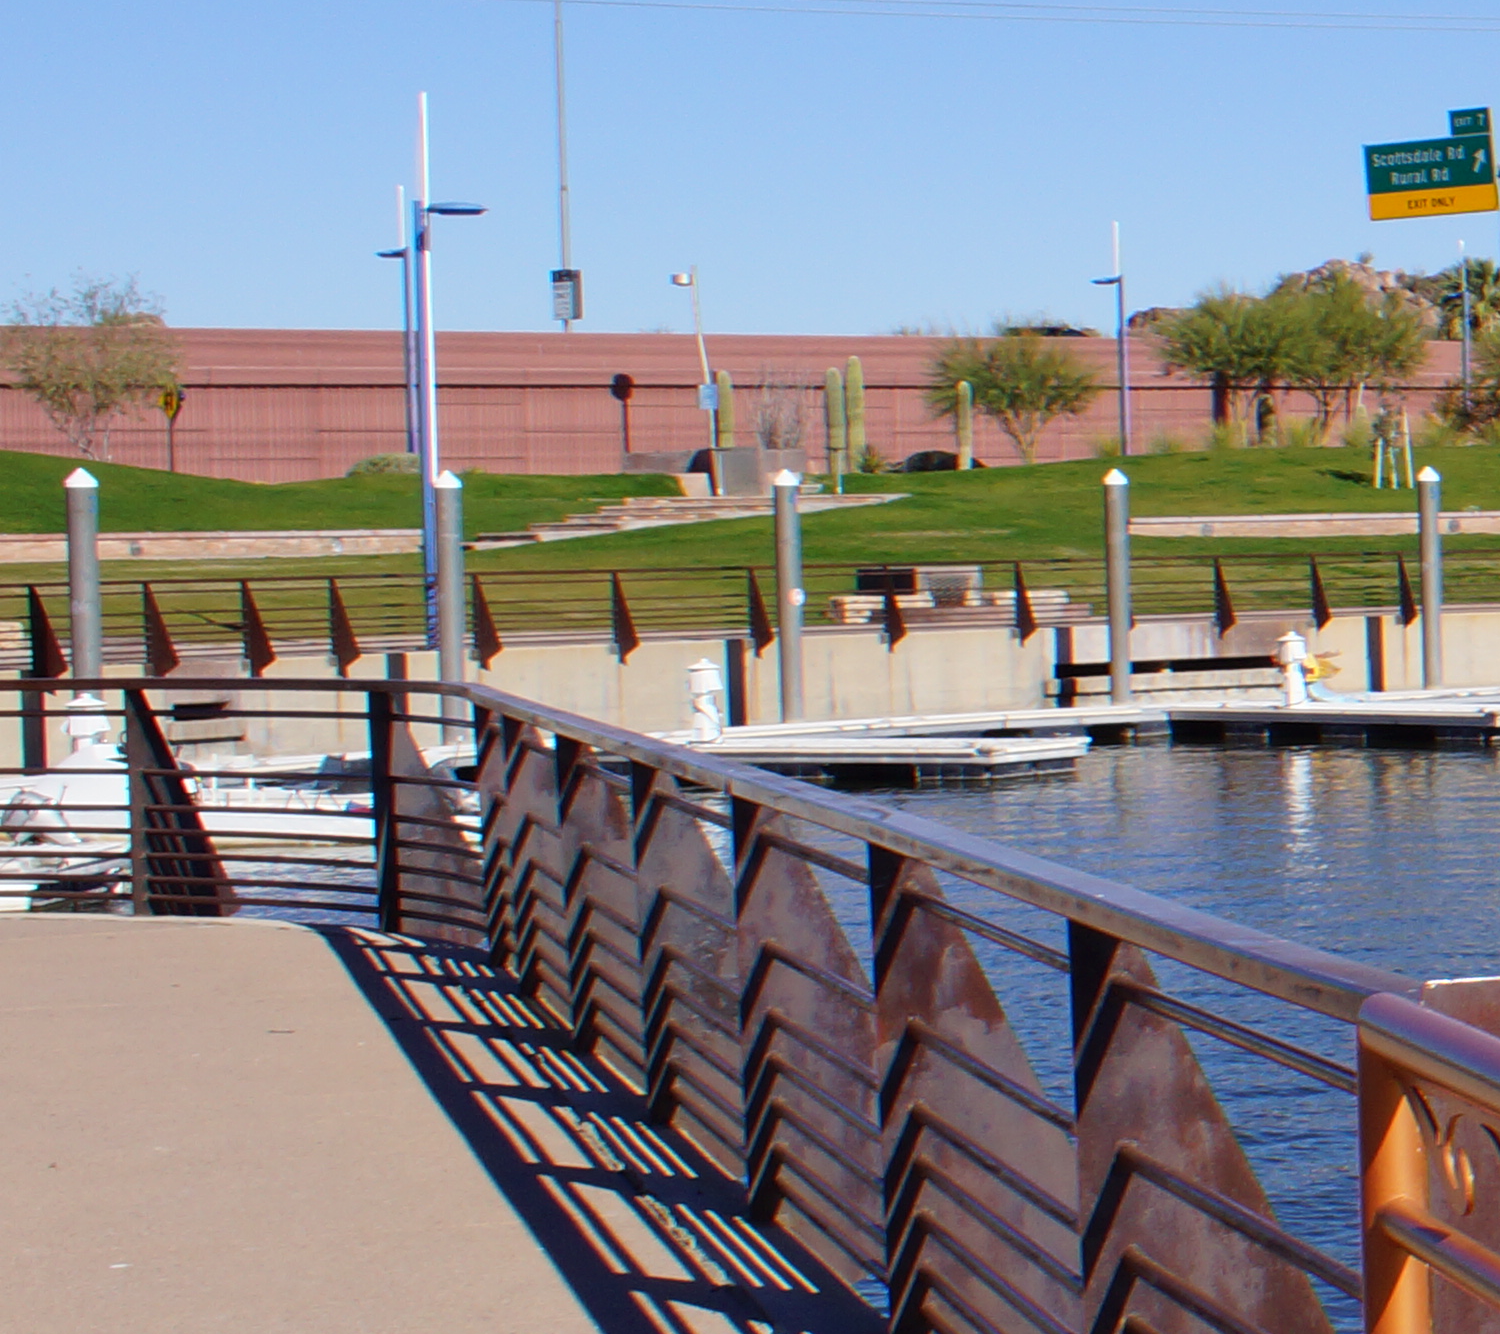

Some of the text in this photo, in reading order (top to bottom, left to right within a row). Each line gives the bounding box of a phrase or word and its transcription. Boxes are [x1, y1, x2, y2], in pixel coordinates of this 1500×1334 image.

[1454, 116, 1472, 127] EXIT
[1372, 145, 1465, 167] Scottsdale Rd
[1390, 167, 1450, 186] Rural Rd
[1407, 197, 1456, 209] EXIT ONLY
